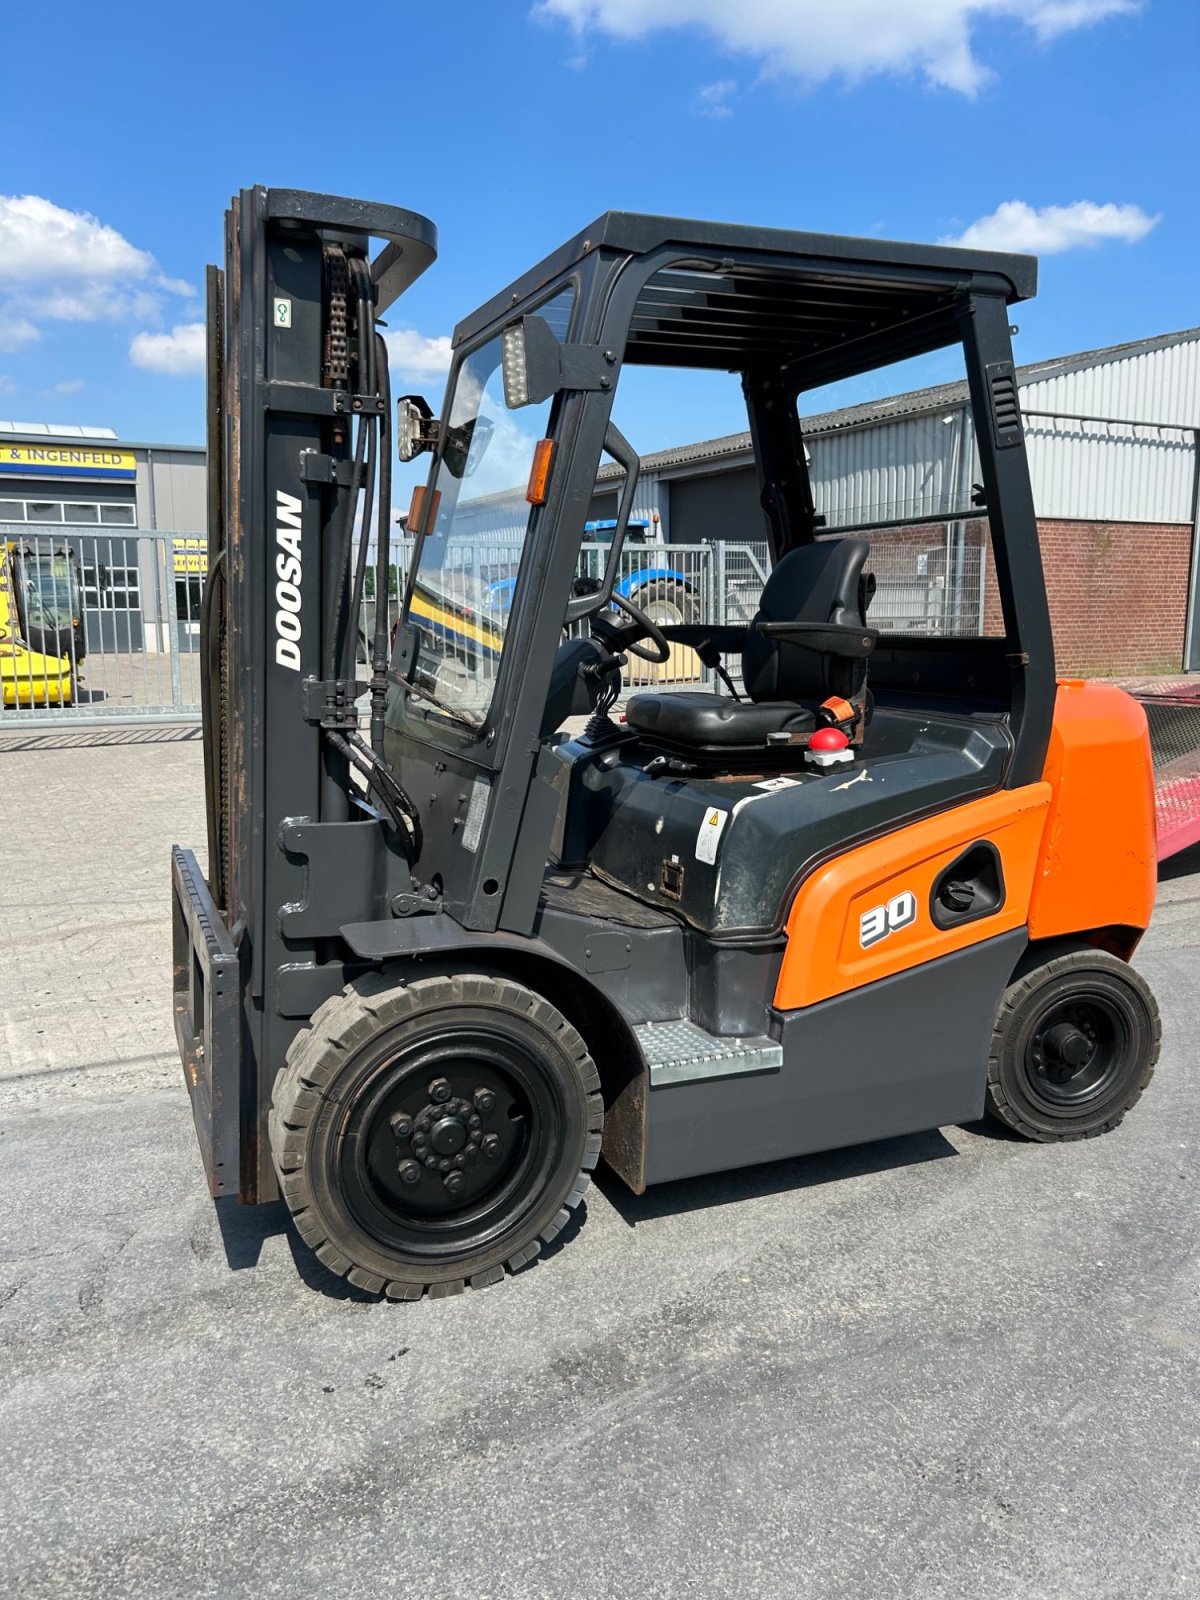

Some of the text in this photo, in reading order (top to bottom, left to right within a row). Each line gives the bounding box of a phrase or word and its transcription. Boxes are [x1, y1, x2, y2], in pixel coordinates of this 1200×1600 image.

[10, 448, 21, 460] &
[27, 448, 122, 465] INGENFELD
[275, 489, 303, 672] DOOSAN
[860, 890, 917, 949] 30
